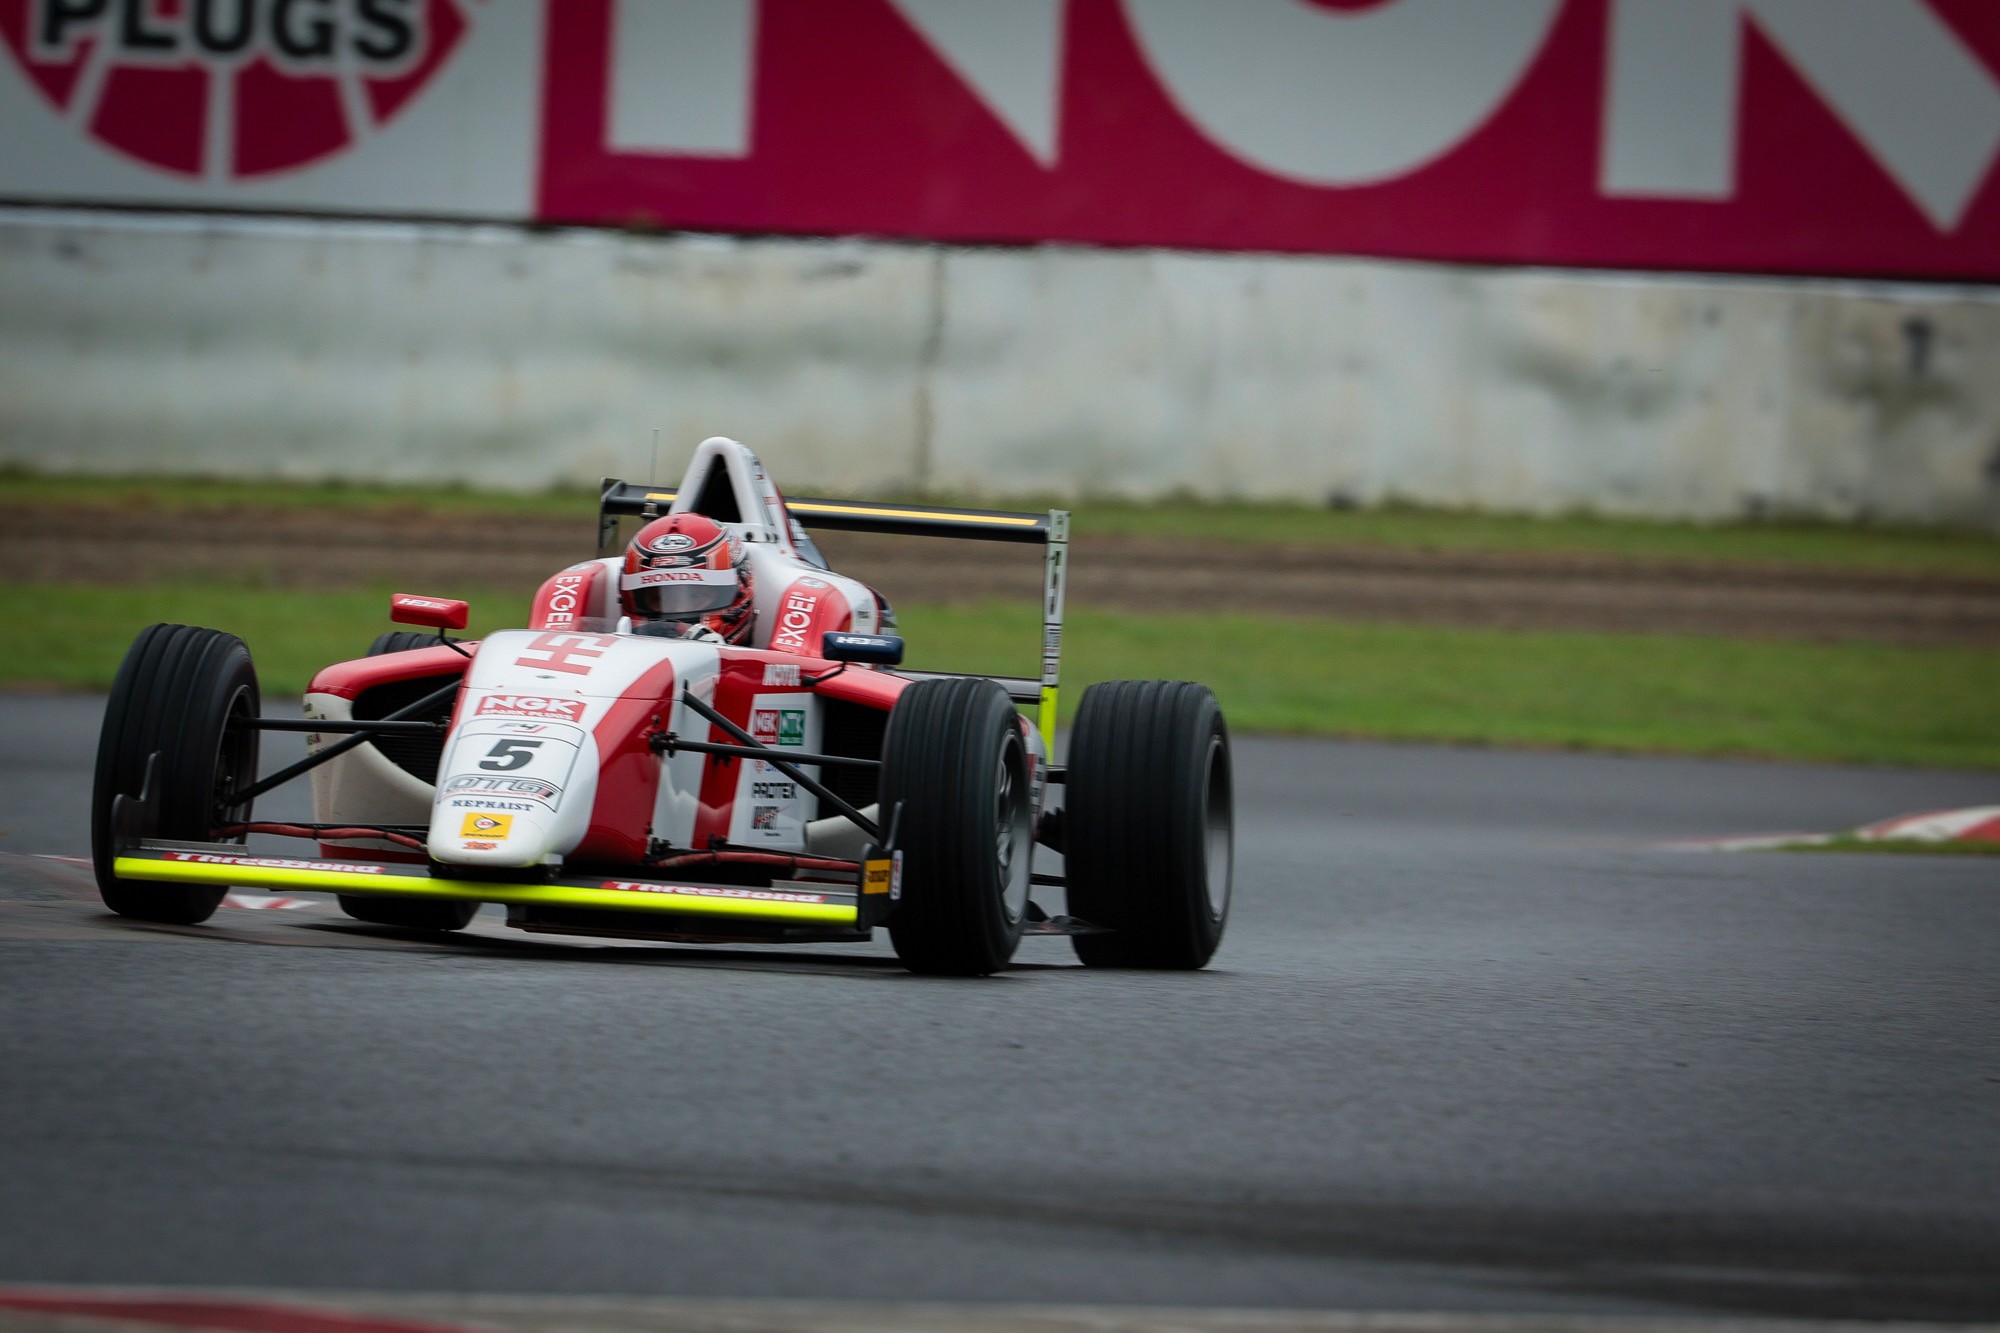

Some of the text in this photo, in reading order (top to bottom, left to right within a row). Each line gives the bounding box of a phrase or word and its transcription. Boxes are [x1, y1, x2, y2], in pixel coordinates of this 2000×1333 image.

[39, 0, 412, 62] PLUGS
[641, 572, 704, 585] HONDA
[482, 696, 580, 715] NGK
[478, 738, 544, 771] 5
[172, 852, 382, 874] ThreeBond
